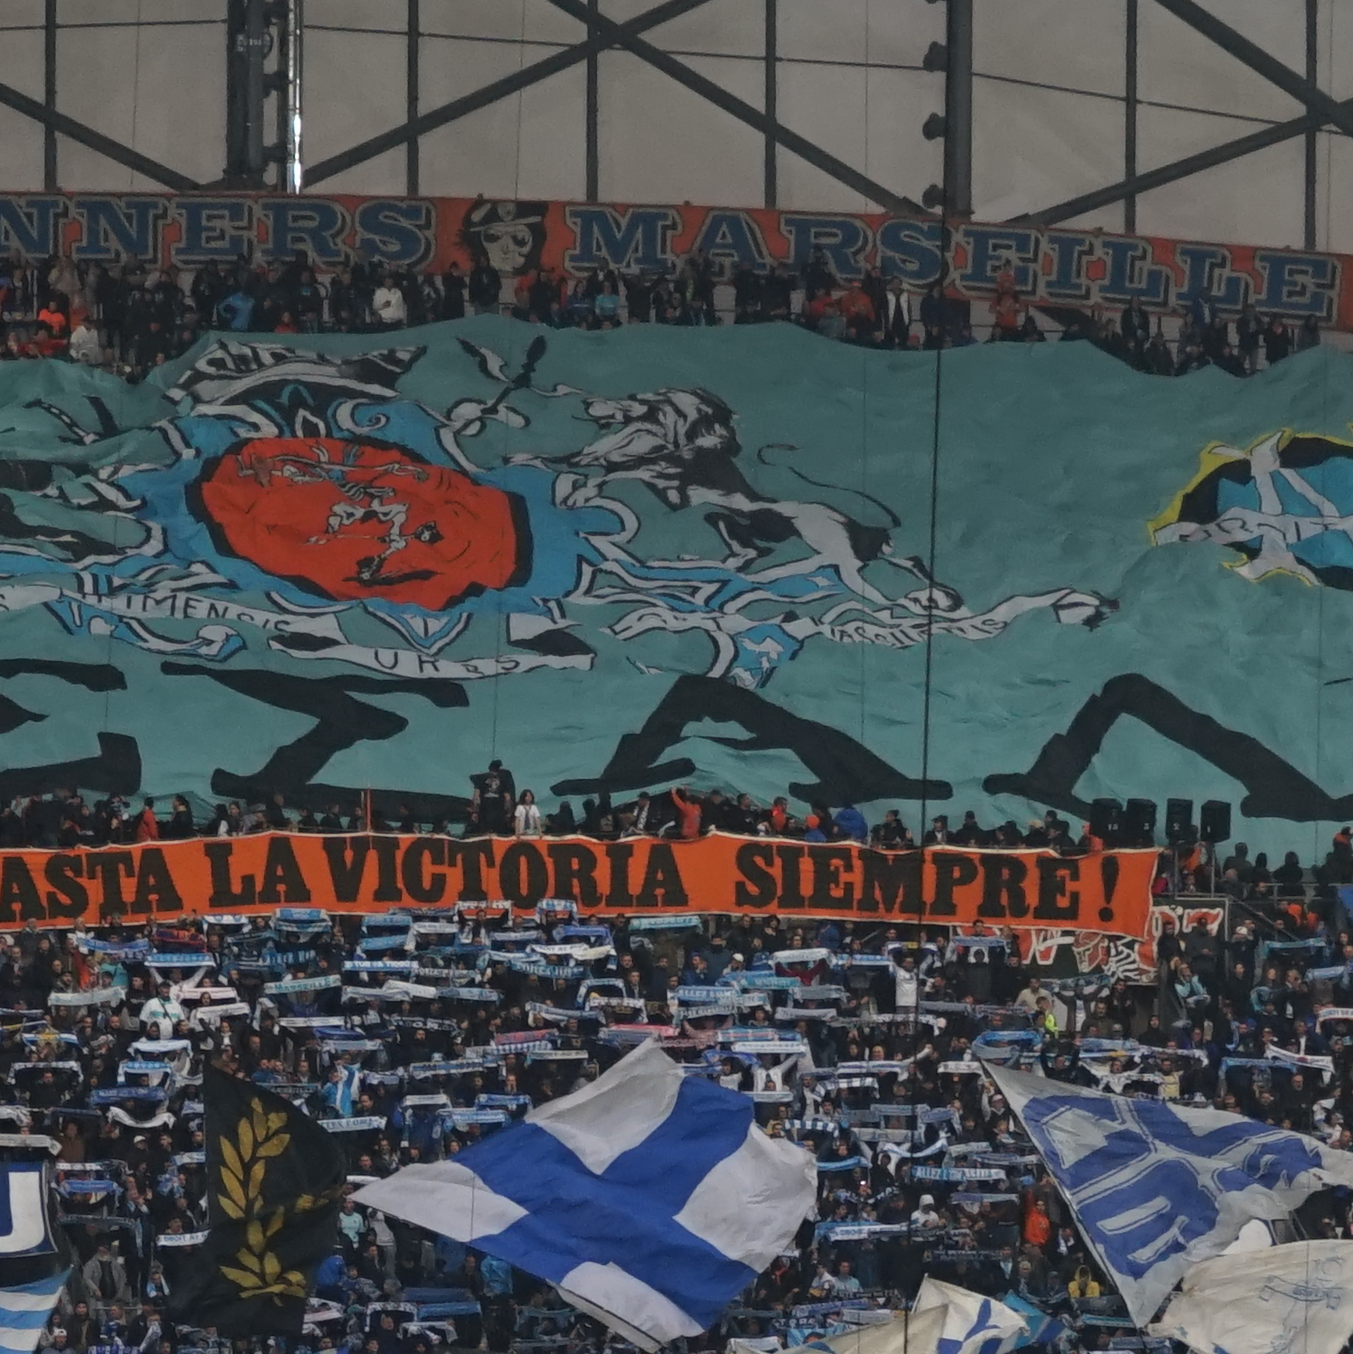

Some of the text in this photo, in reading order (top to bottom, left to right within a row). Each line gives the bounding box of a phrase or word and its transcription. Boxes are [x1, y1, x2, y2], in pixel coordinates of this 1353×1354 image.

[563, 204, 1343, 325] MARSEILLE
[209, 835, 311, 911] LA
[320, 836, 690, 909] VICTORIA
